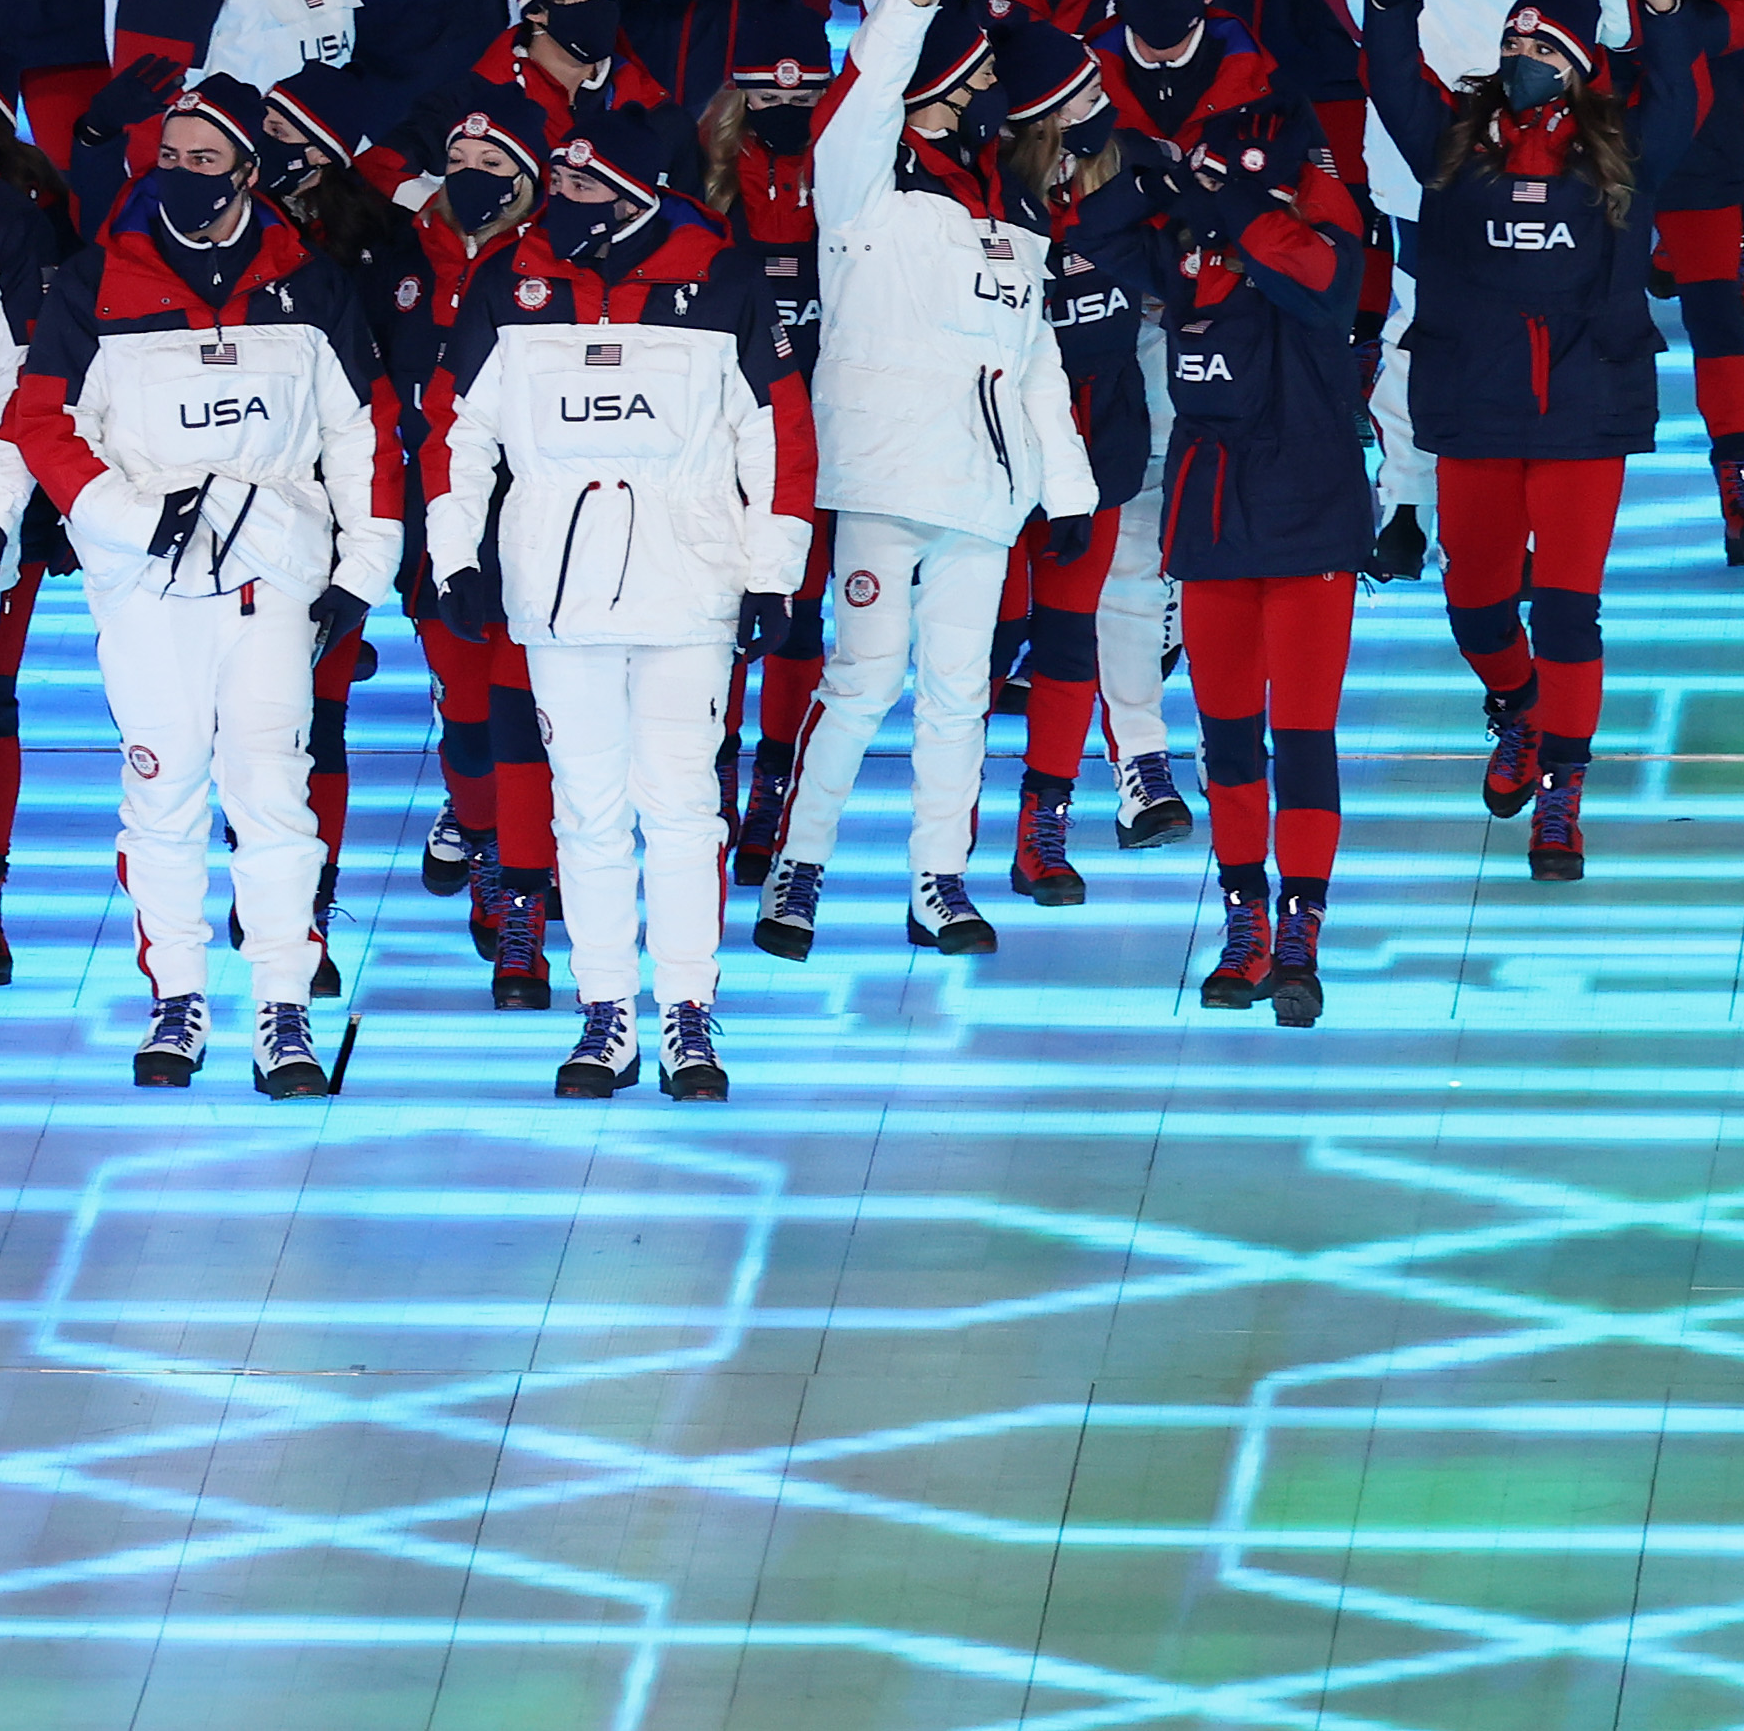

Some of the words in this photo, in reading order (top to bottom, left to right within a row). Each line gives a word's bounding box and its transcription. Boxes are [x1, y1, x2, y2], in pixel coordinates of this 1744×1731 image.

[300, 31, 355, 63] USA
[1488, 221, 1575, 250] USA
[777, 300, 820, 325] SA
[1046, 288, 1130, 327] USA
[180, 397, 270, 428] USA
[561, 394, 656, 421] USA
